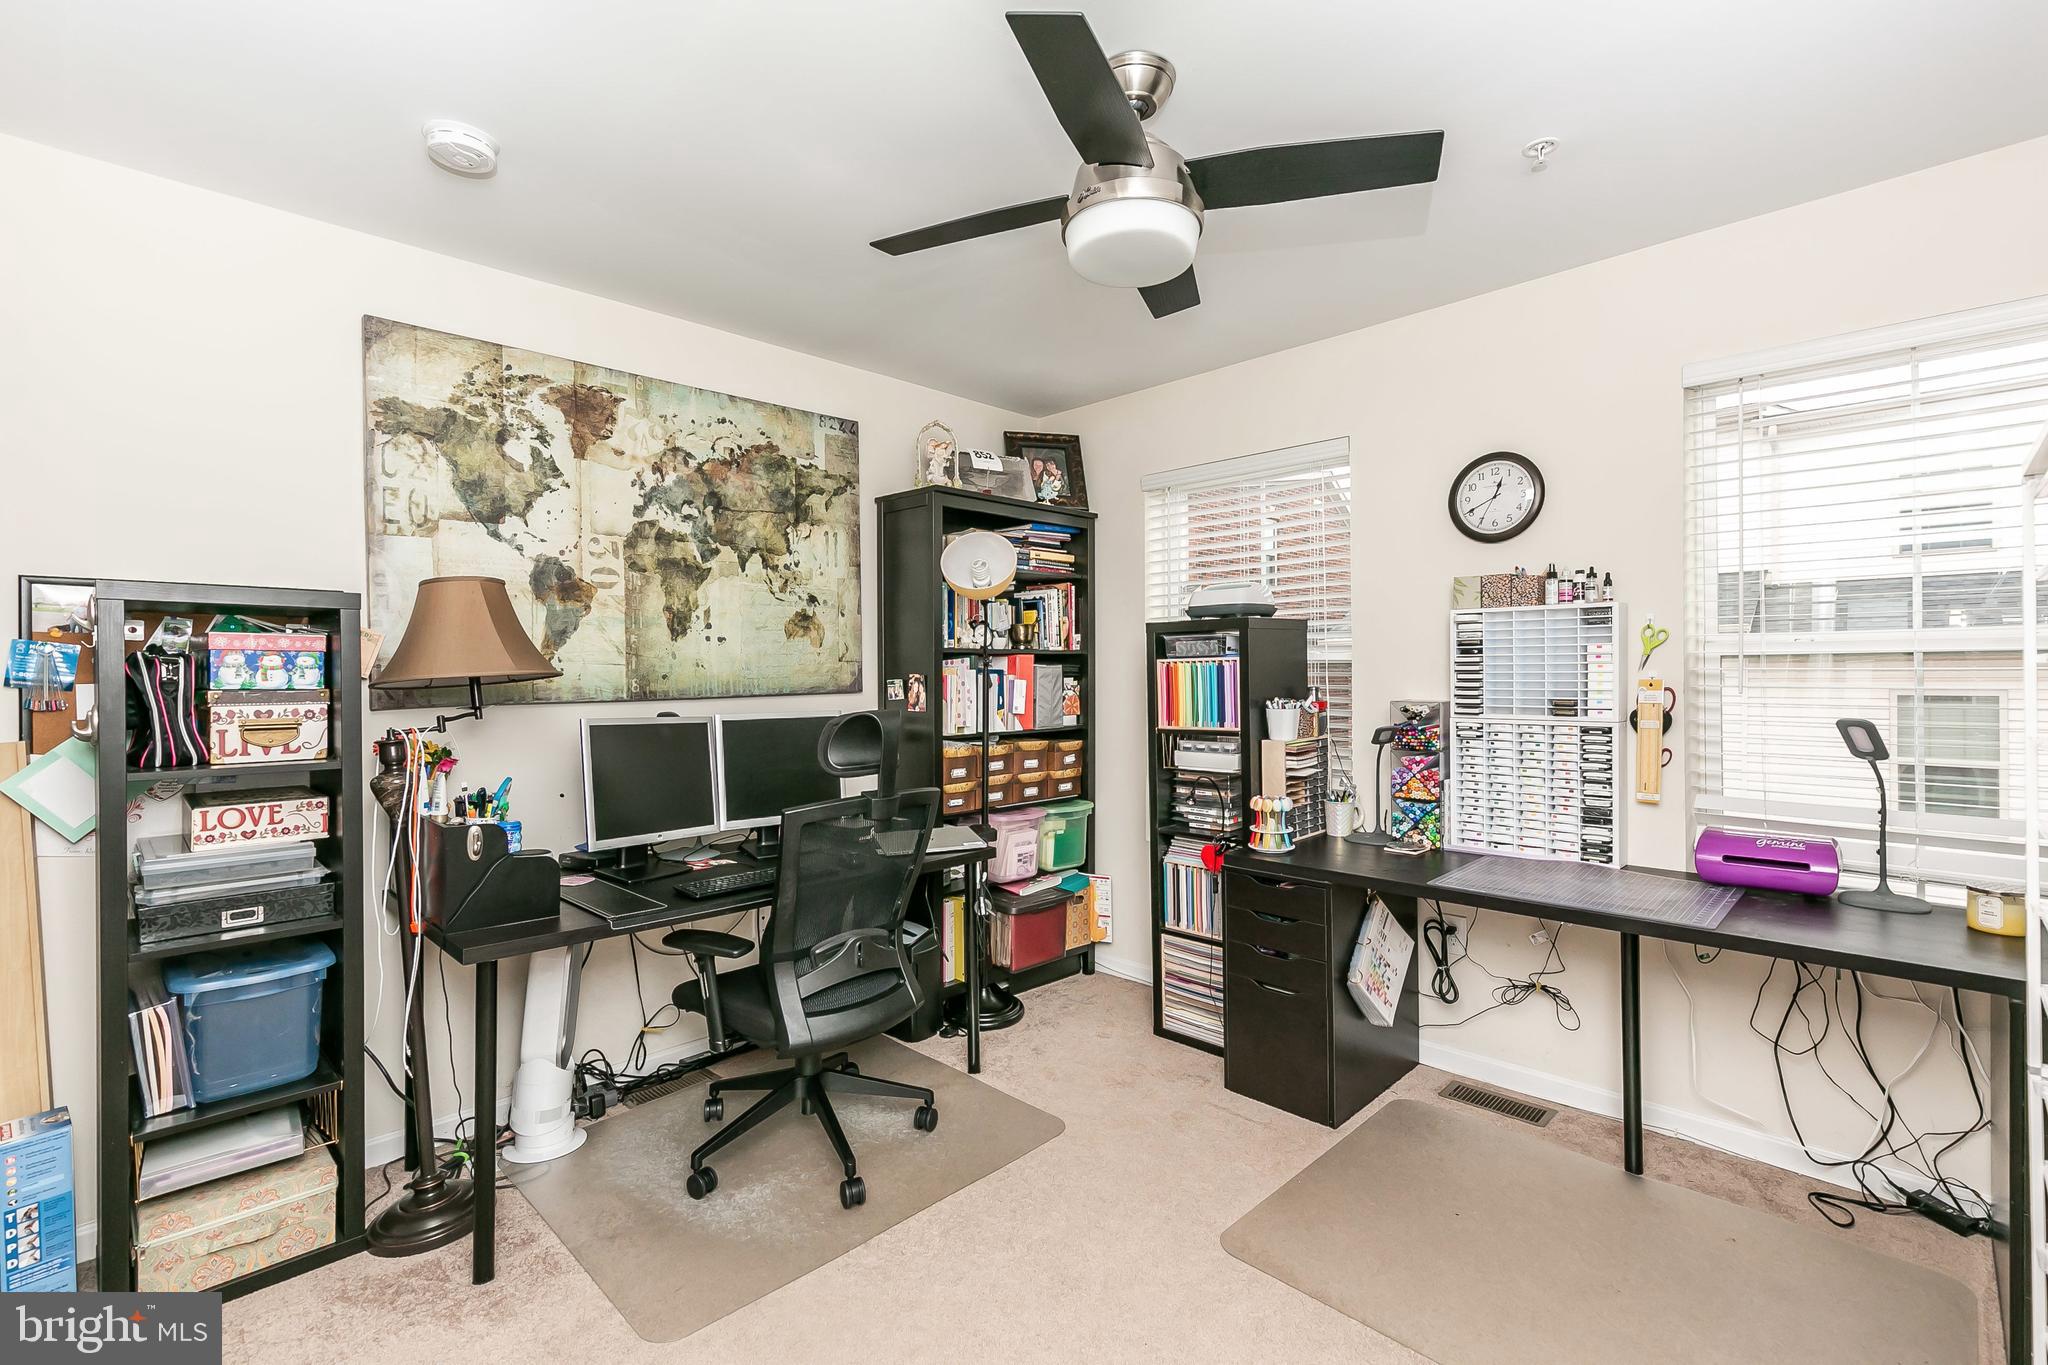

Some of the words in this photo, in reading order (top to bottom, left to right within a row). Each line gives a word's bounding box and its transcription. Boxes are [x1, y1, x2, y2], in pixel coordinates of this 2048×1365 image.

[1490, 467, 1500, 476] 12
[1507, 468, 1511, 477] 1
[1478, 472, 1485, 481] 11
[1517, 476, 1524, 485] 2
[1468, 483, 1477, 492] 10
[1520, 489, 1527, 498] 3
[1464, 496, 1471, 505] 9
[1515, 502, 1522, 511] 4
[1506, 513, 1513, 522] 5
[1492, 519, 1499, 527] 6
[198, 803, 284, 832] LOVE
